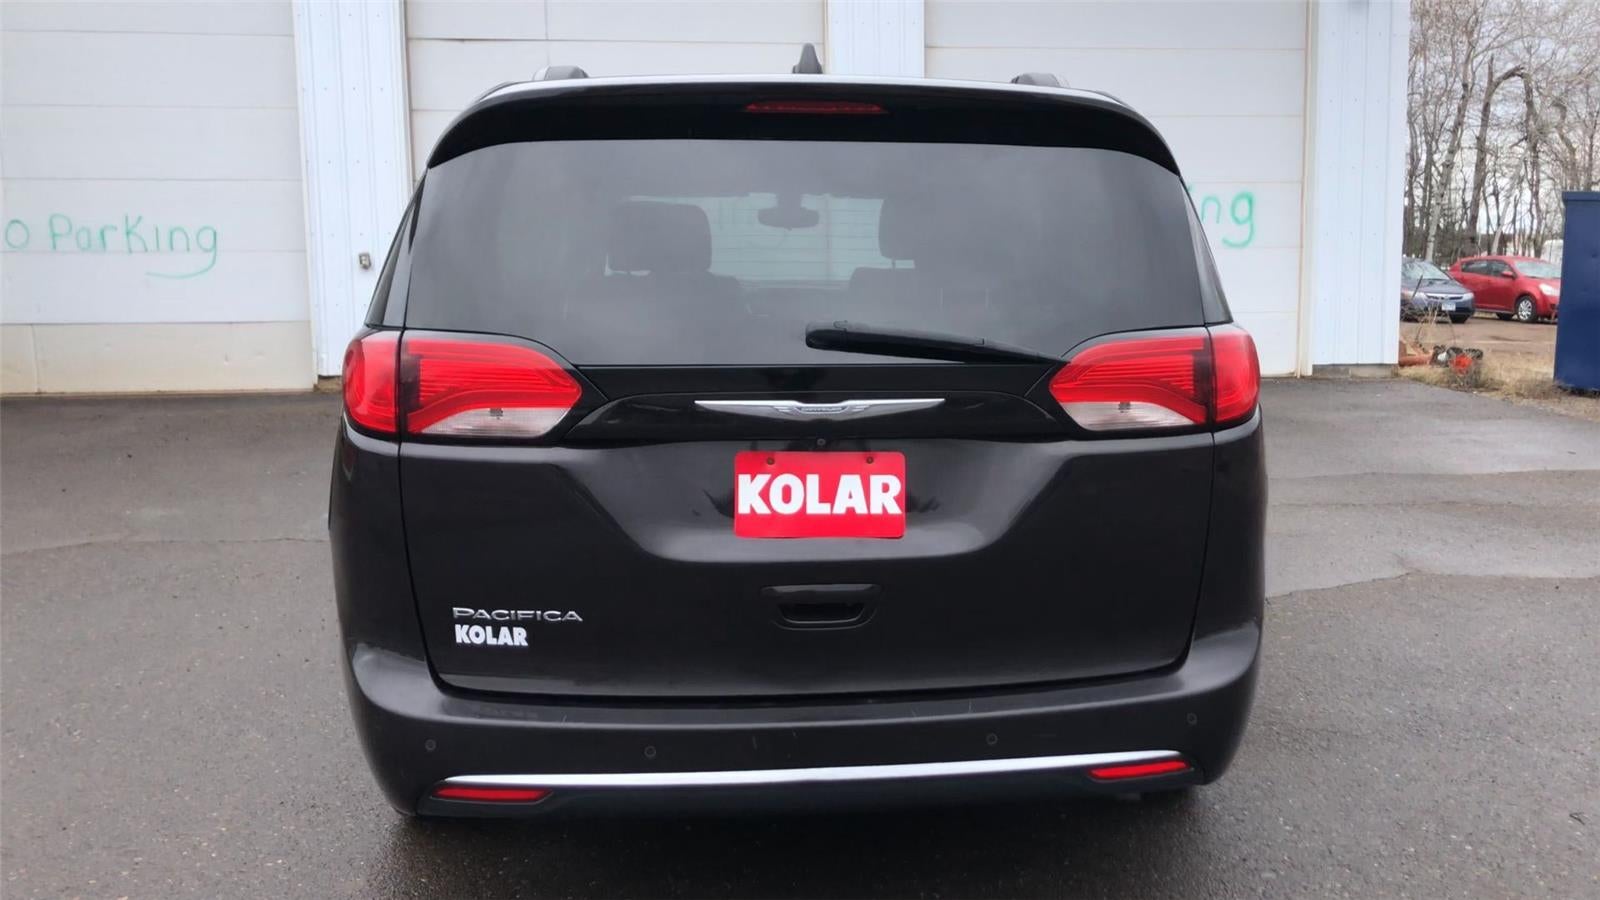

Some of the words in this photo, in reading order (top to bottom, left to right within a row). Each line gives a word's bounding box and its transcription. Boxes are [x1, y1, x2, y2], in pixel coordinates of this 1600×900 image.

[1187, 186, 1254, 249] ng
[737, 473, 902, 515] KOLAR
[452, 607, 583, 622] PACIFICA
[454, 624, 528, 646] KOLAR
